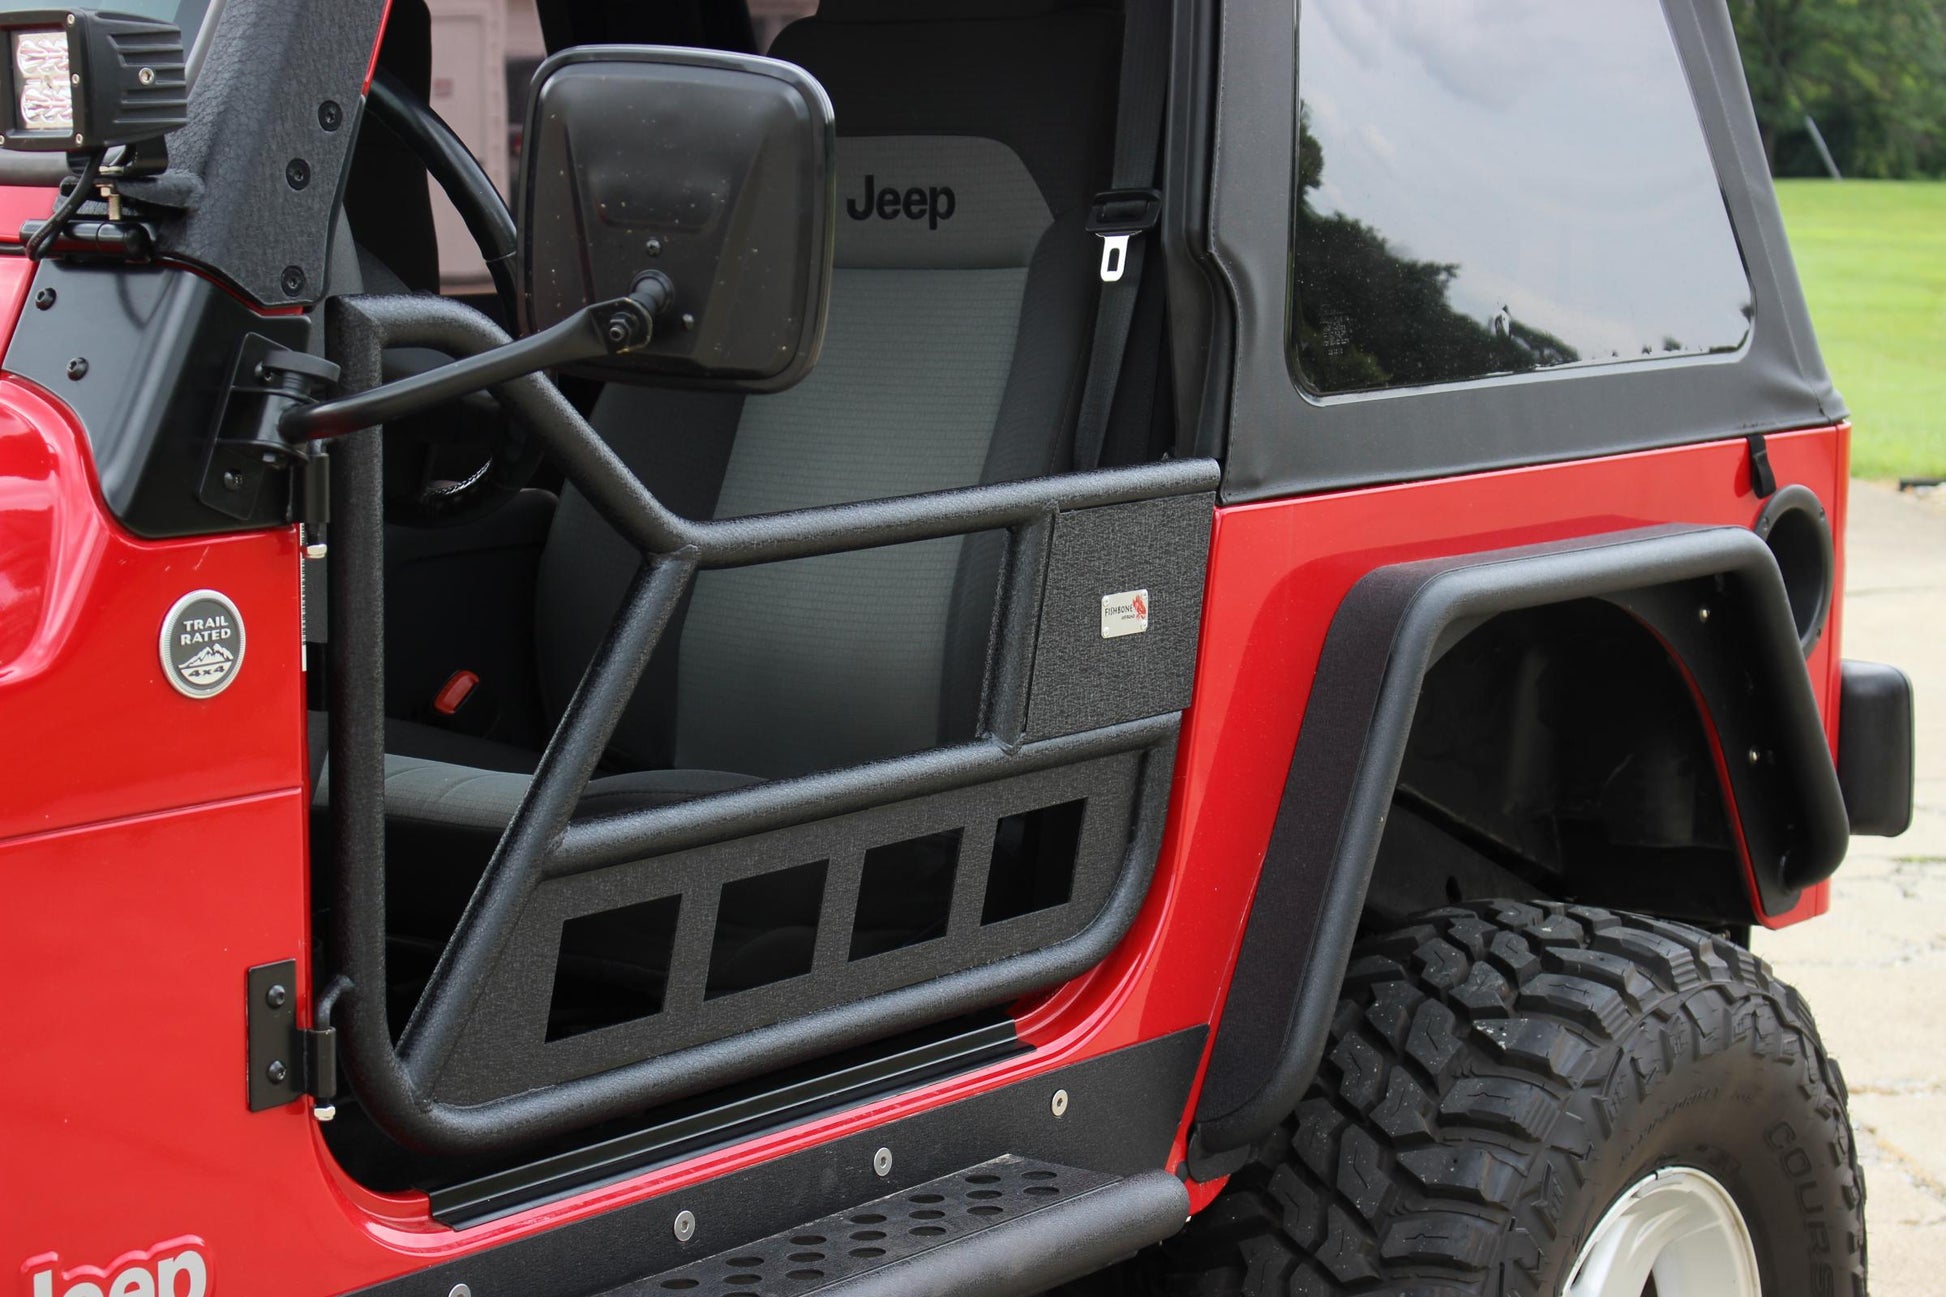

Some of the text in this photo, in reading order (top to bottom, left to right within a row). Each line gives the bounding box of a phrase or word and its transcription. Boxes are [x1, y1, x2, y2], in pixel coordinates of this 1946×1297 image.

[847, 174, 956, 231] Jeep
[183, 616, 229, 632] TRAIL
[180, 628, 231, 646] RATED
